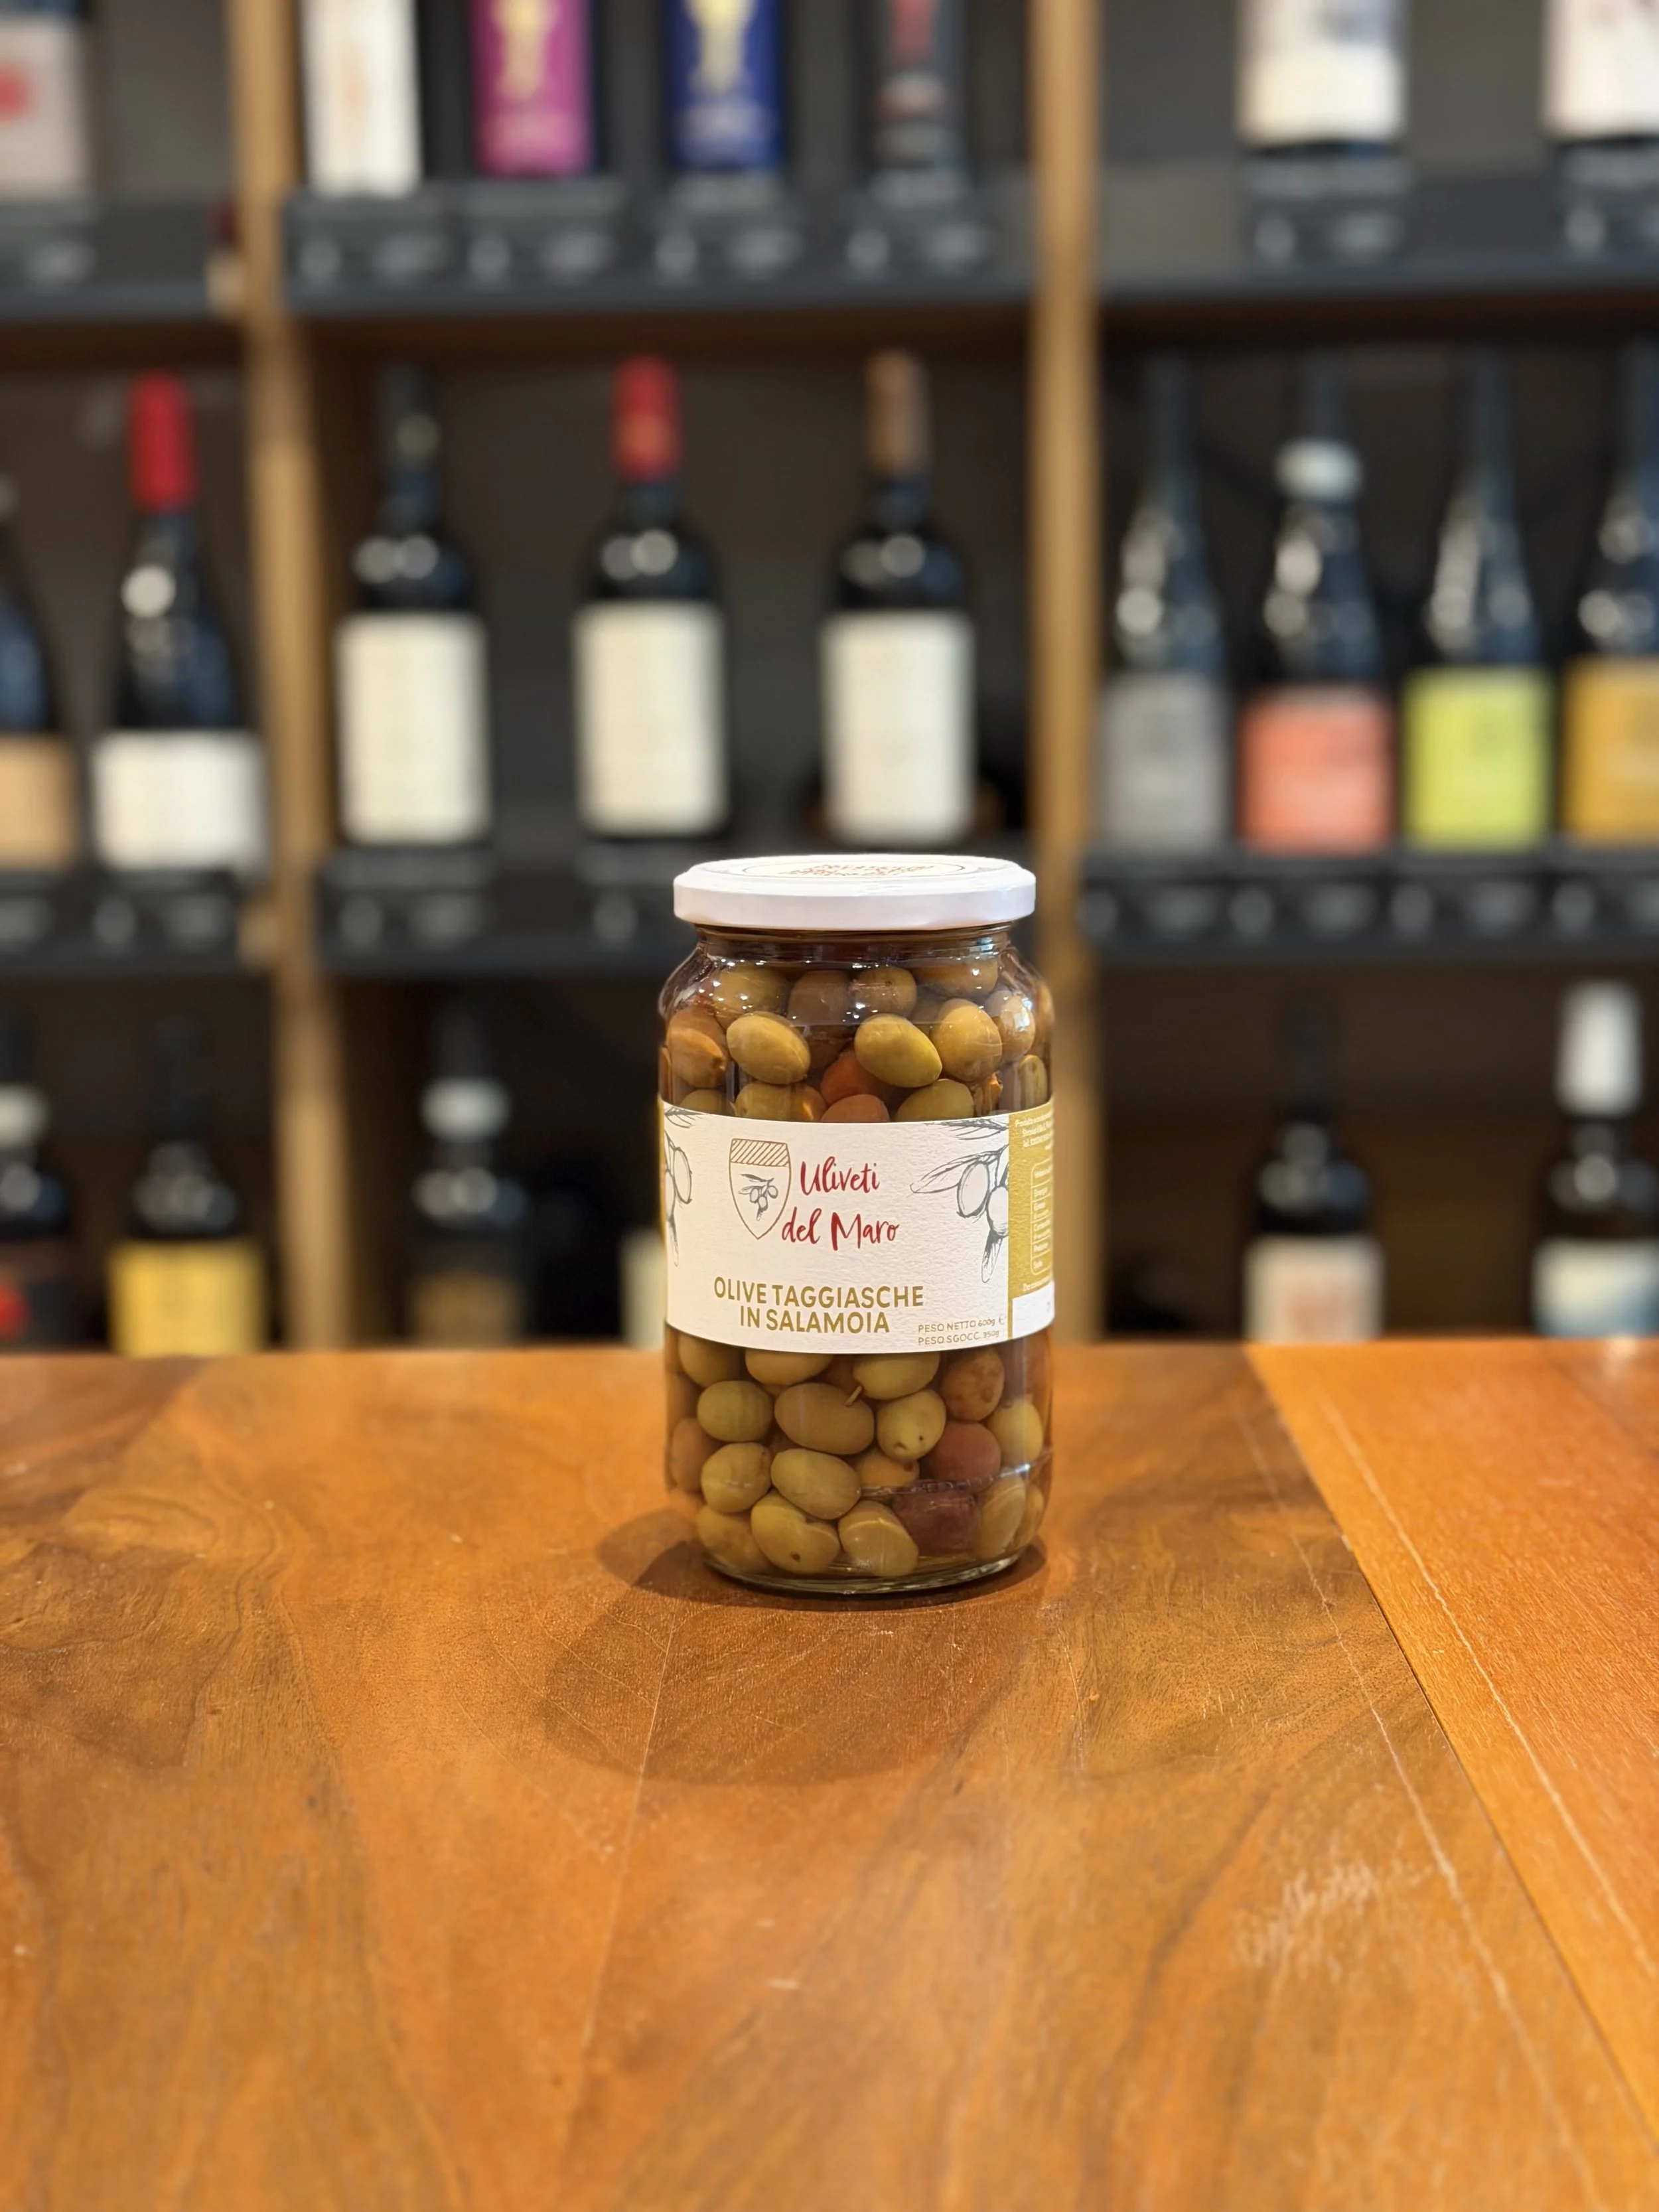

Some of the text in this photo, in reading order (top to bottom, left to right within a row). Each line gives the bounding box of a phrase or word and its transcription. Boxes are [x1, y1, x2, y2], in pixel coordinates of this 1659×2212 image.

[800, 1156, 880, 1195] Uliveti
[782, 1206, 900, 1251] del Maro
[714, 1276, 924, 1309] OLIVE TAGGIASCHE
[741, 1305, 890, 1333] IN SALAMOIA
[918, 1323, 944, 1333] PESO
[946, 1320, 976, 1331] NETTO
[918, 1336, 944, 1345] PESO
